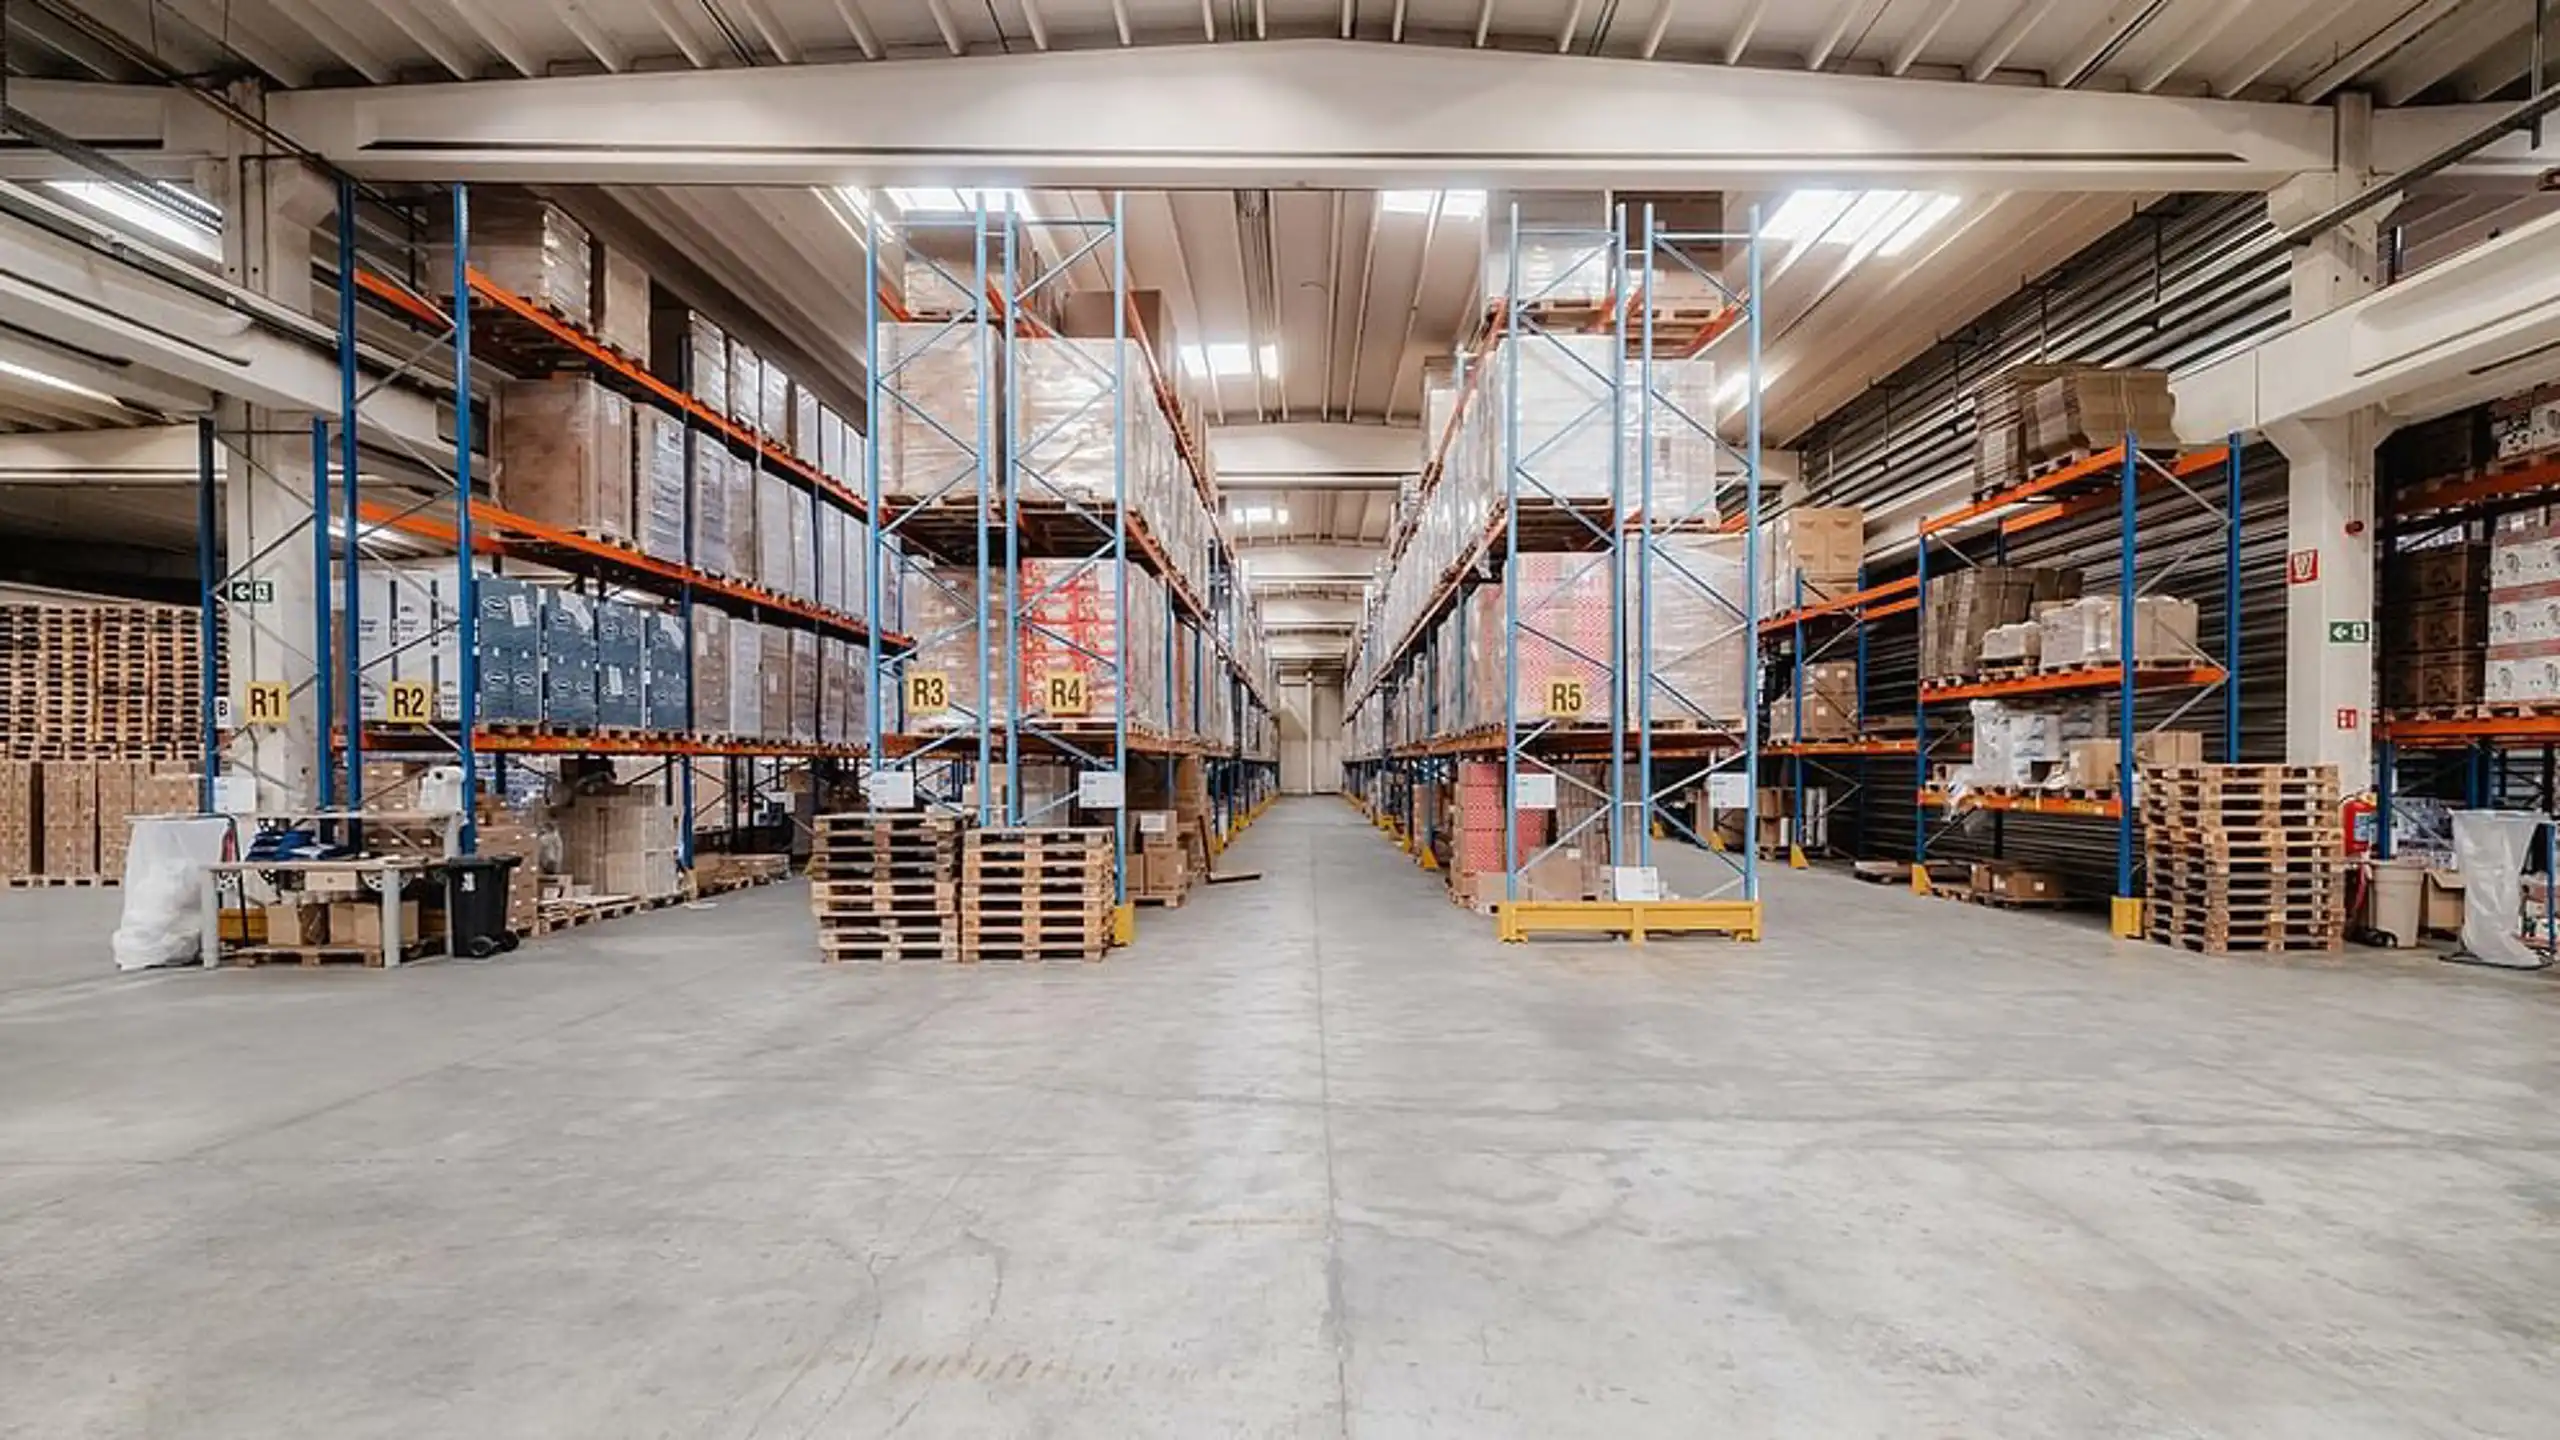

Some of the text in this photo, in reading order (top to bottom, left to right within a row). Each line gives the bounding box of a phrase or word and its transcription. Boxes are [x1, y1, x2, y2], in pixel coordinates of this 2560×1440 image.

[251, 687, 280, 717] R1
[393, 688, 424, 717] R2
[913, 678, 943, 706] R3
[1051, 678, 1082, 707] R4
[1552, 683, 1582, 711] R5
